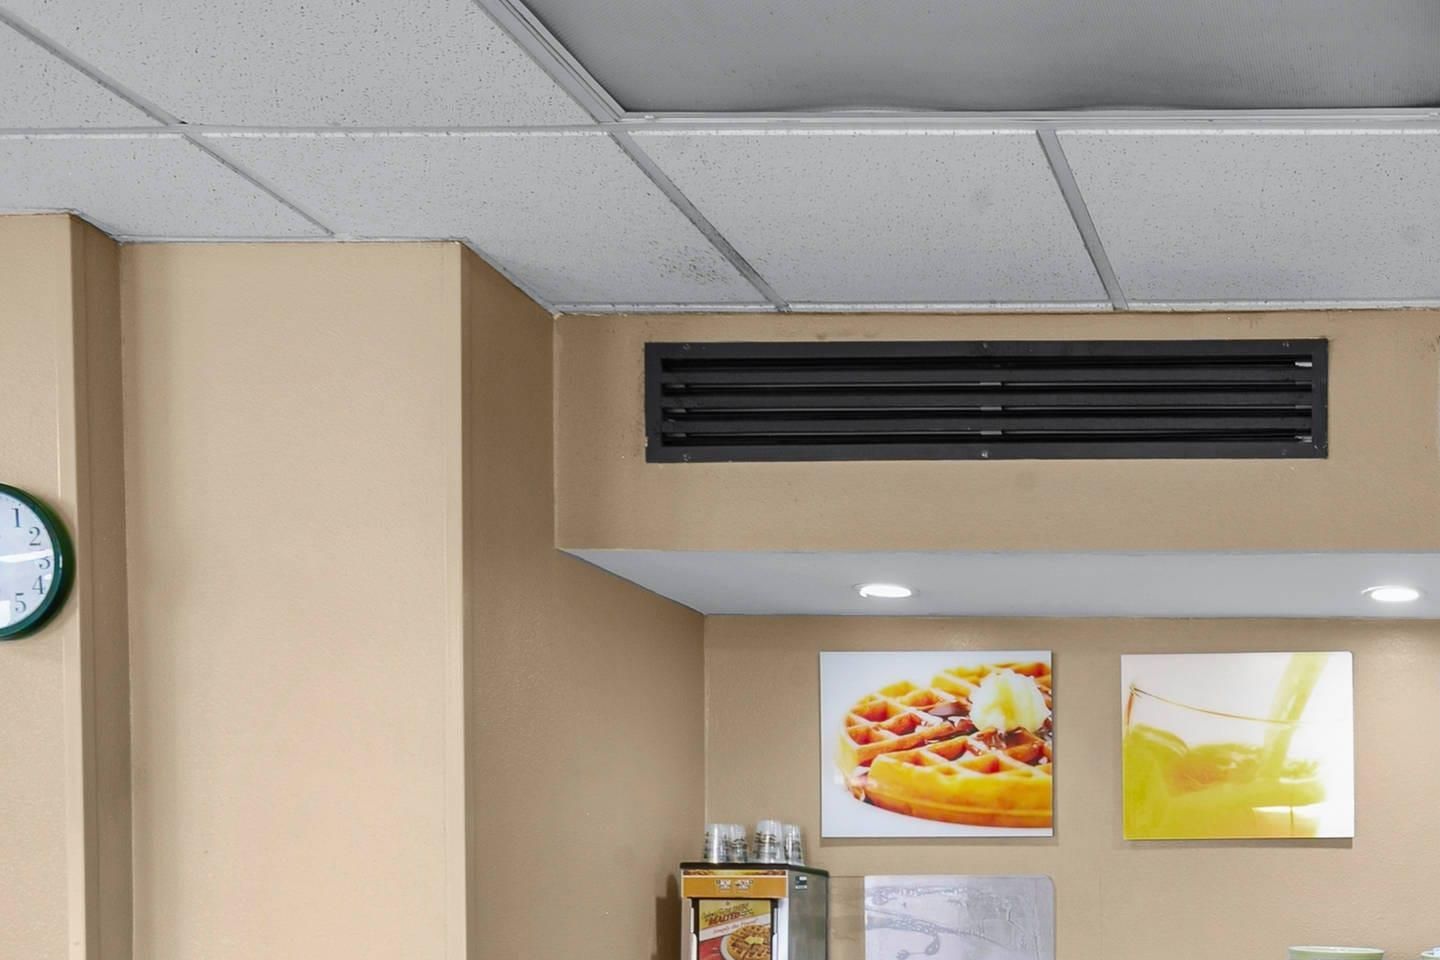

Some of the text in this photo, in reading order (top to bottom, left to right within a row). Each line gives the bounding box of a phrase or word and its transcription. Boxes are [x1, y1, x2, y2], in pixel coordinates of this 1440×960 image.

[11, 508, 20, 528] 1
[29, 526, 41, 546] 2
[32, 575, 45, 595] 4
[15, 592, 27, 613] 5
